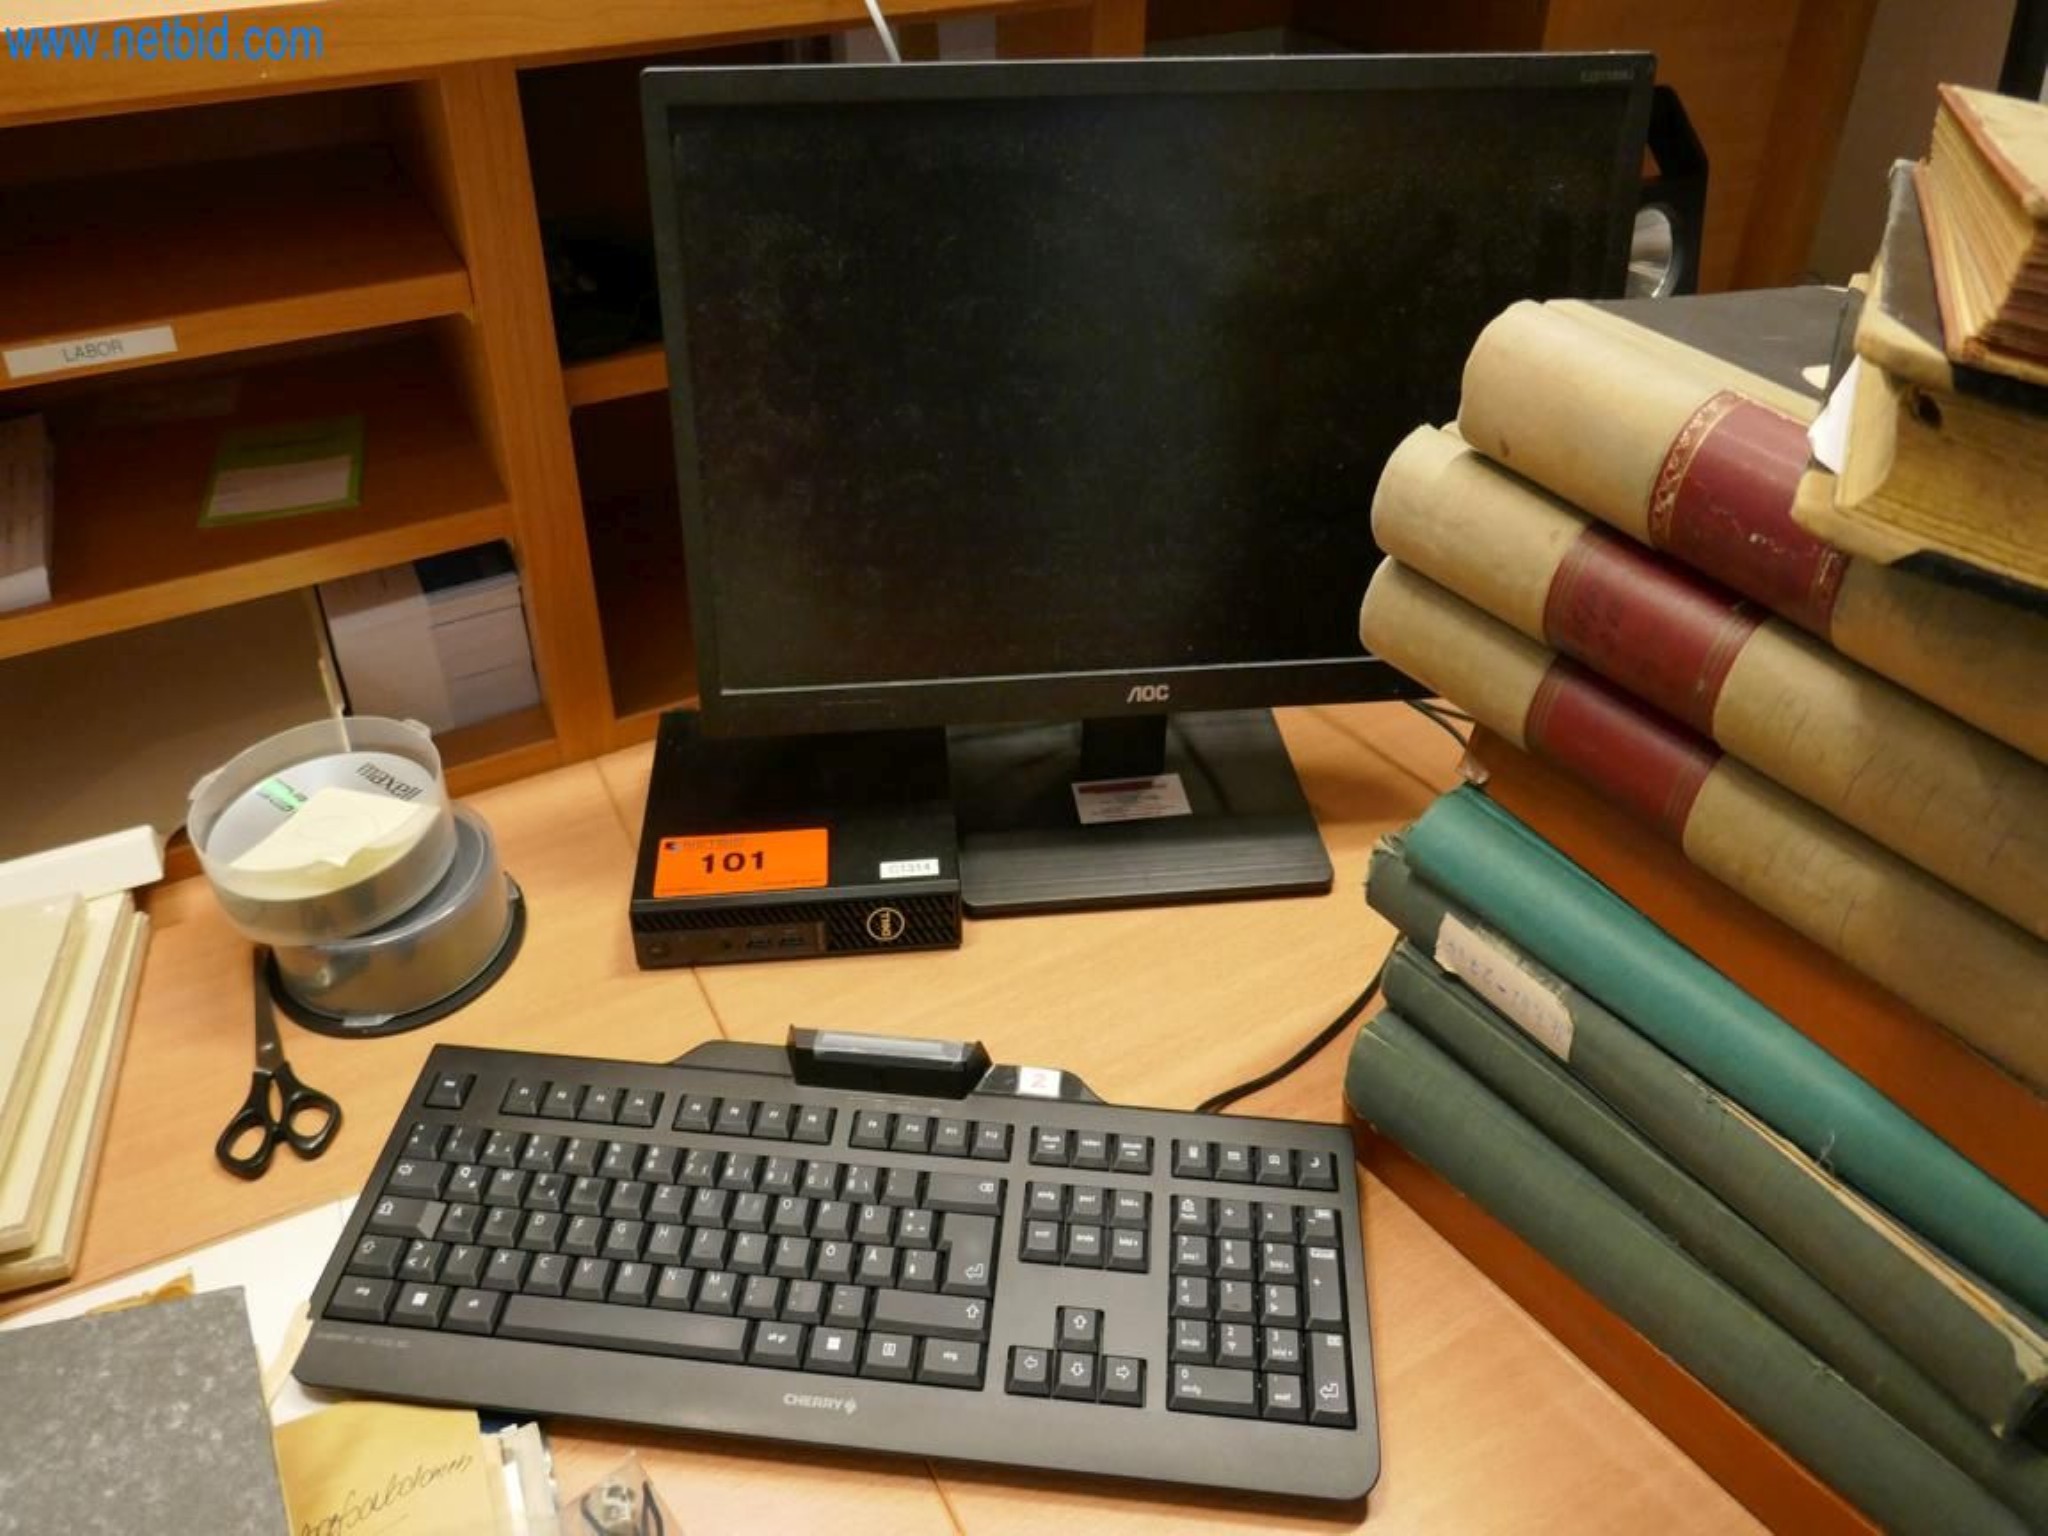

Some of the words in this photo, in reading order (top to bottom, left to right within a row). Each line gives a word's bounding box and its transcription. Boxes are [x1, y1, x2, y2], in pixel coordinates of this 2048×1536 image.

[60, 339, 124, 363] LABOR
[1126, 684, 1170, 704] AOC
[355, 762, 424, 802] maxell
[702, 850, 764, 874] 101
[783, 1392, 843, 1411] CHERRY
